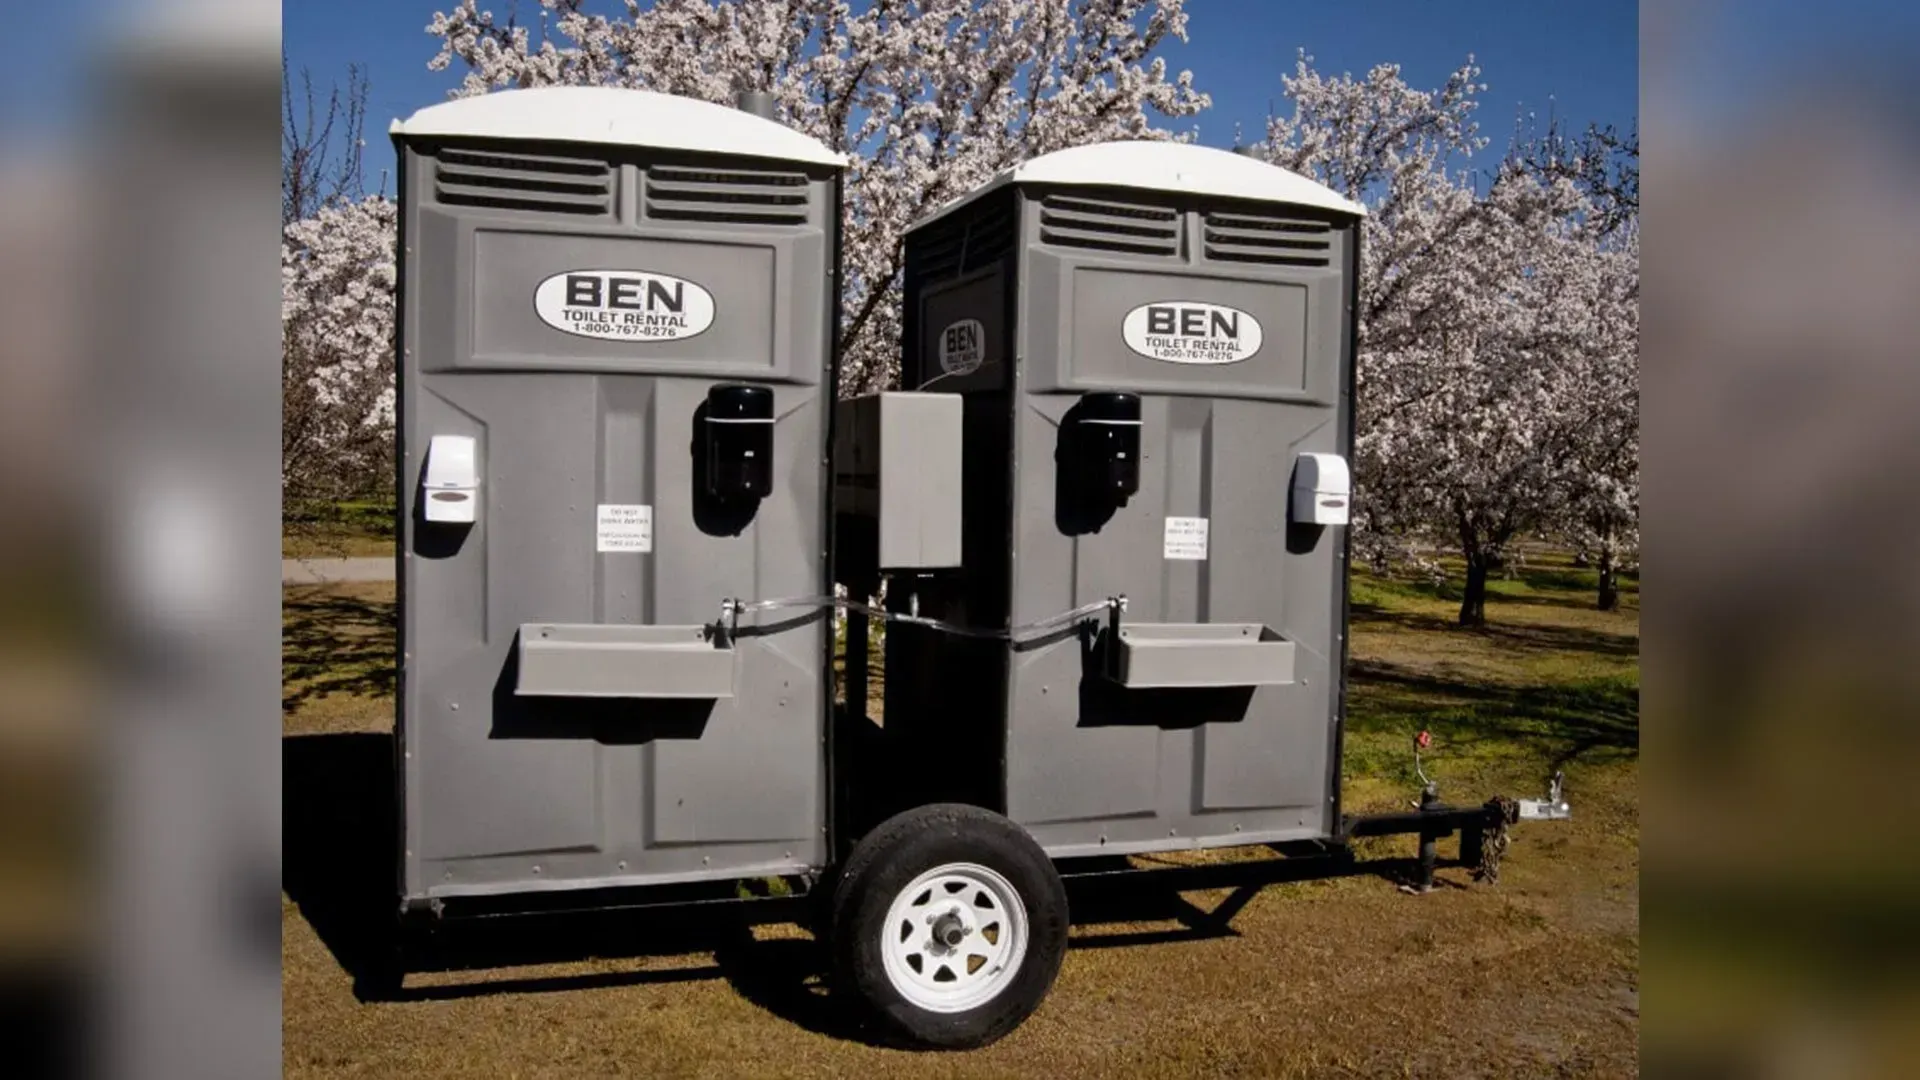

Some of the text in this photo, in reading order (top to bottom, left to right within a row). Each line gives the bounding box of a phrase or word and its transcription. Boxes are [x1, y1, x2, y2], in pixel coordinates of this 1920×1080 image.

[566, 275, 684, 313] BEN
[562, 309, 688, 328] TOILET RENTAL
[1147, 306, 1238, 338] BEN
[574, 322, 677, 337] 1-800-767-8276
[946, 323, 978, 353] BEN
[1144, 336, 1242, 352] TOILET RENTAL
[1154, 348, 1233, 361] 1-800-767-8276
